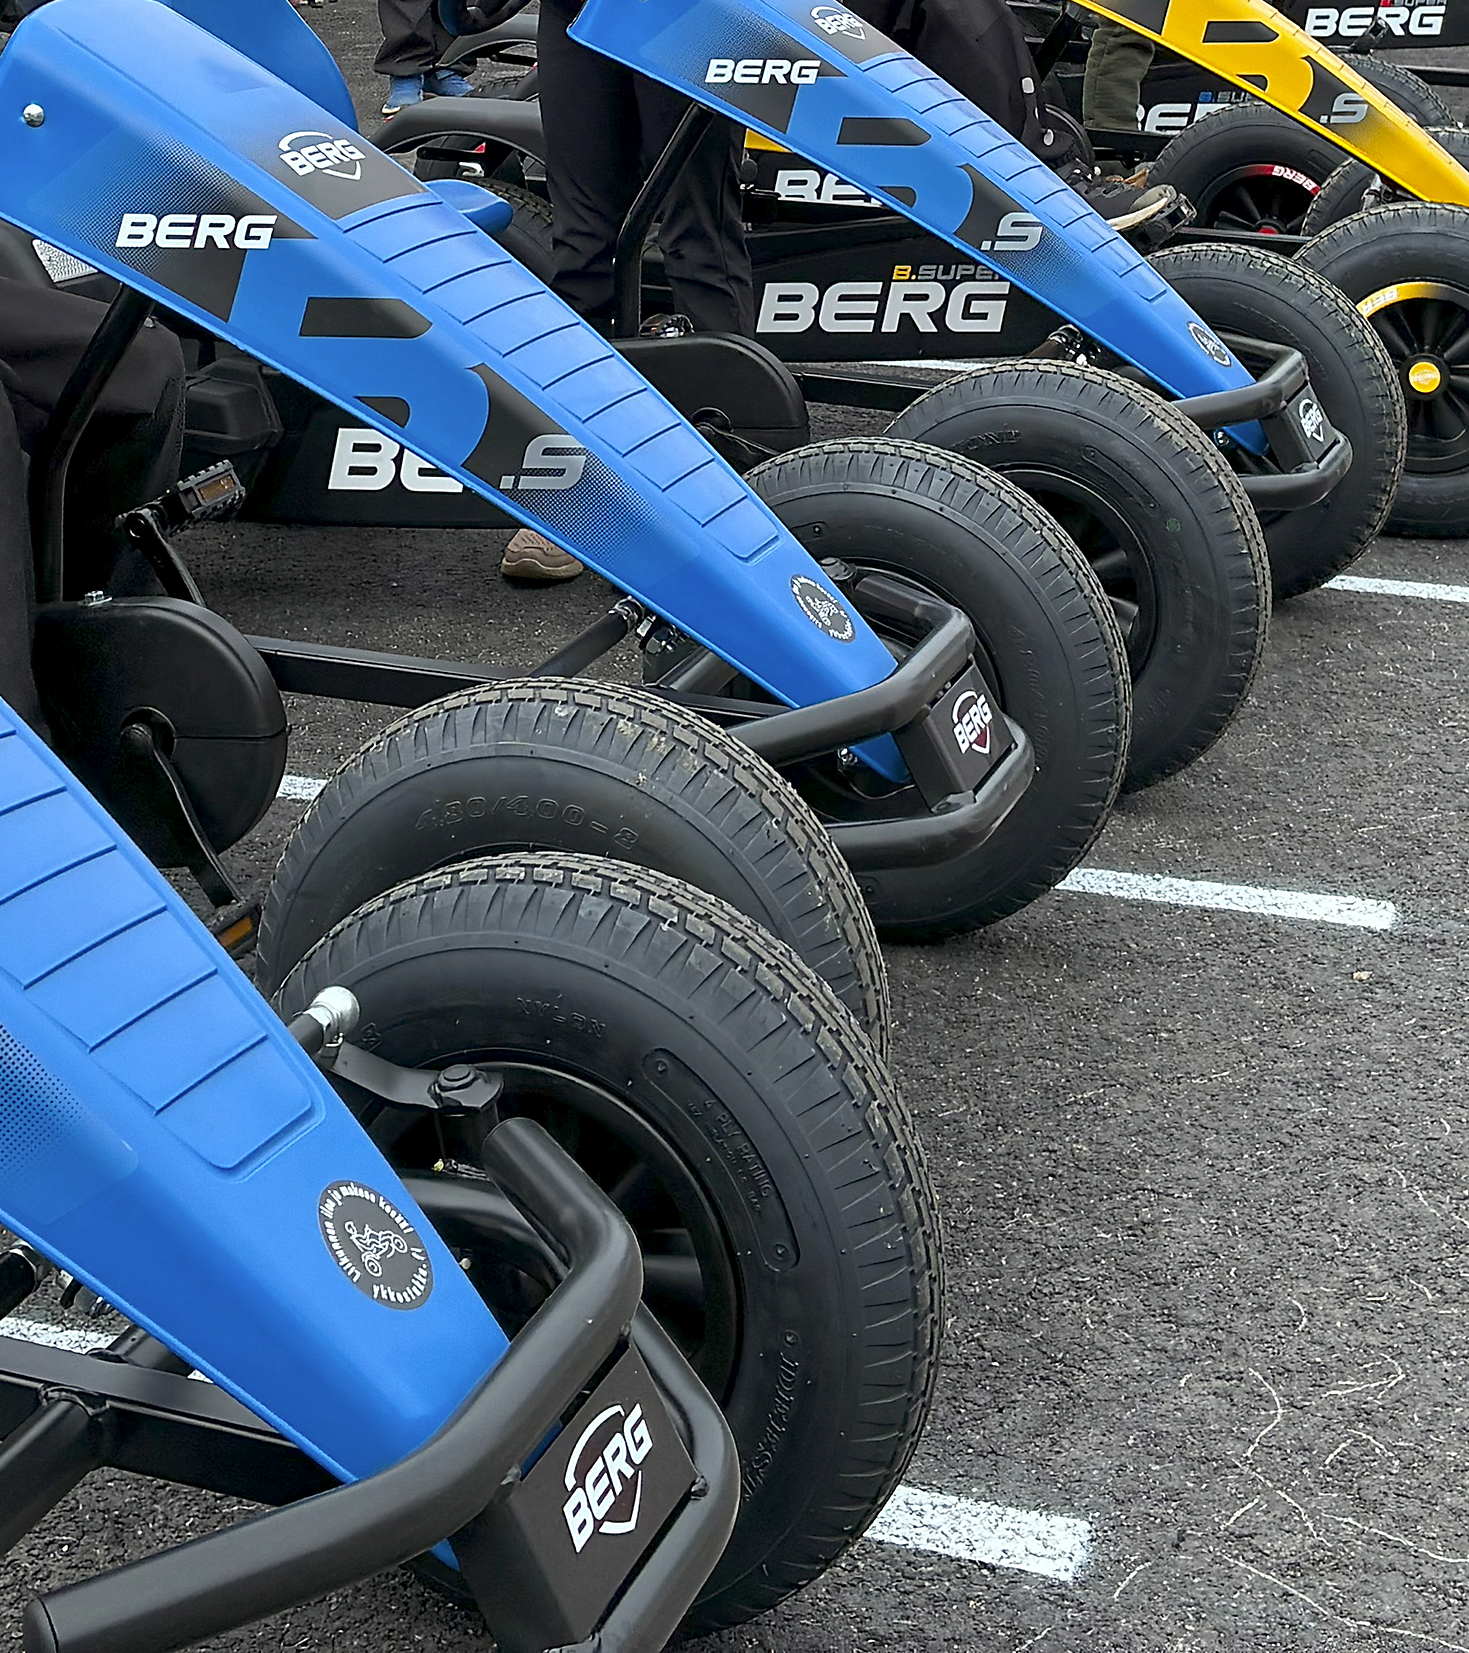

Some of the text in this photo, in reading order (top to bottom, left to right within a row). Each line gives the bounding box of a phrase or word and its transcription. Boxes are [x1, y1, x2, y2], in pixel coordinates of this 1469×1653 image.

[814, 13, 863, 35] BERG
[1305, 6, 1446, 36] BERG
[705, 59, 820, 85] BERG
[280, 138, 366, 177] BERG
[116, 212, 278, 250] BERG
[756, 282, 1010, 333] BERG
[953, 693, 993, 754] BERG
[563, 1403, 653, 1553] BERG
